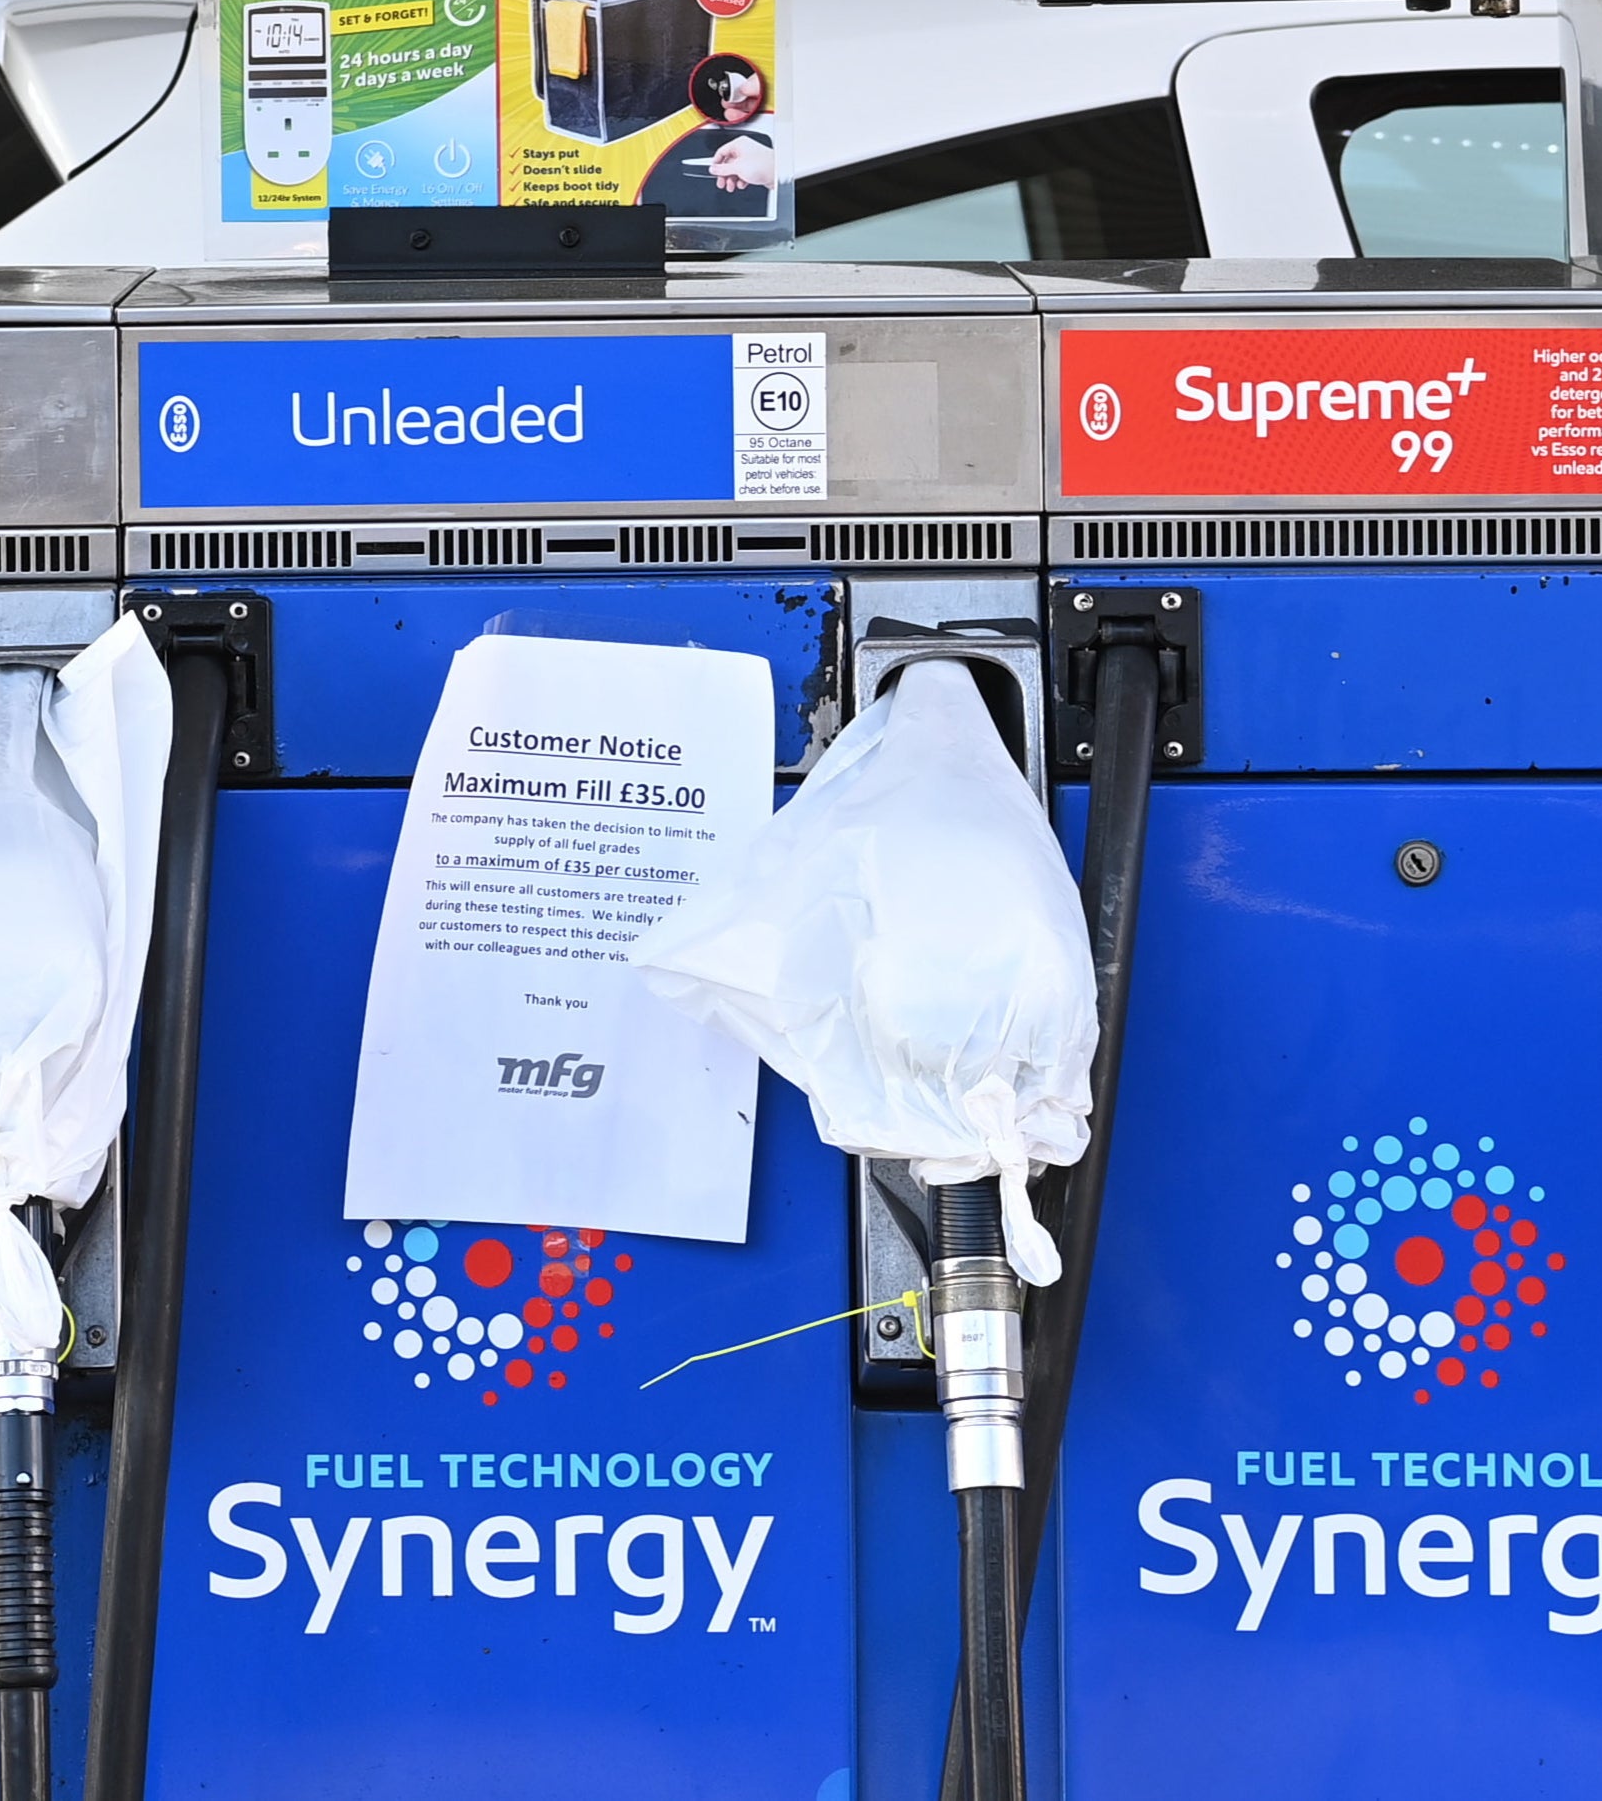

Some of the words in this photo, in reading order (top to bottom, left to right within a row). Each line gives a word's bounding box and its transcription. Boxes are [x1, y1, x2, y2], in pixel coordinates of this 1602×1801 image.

[747, 342, 813, 364] Petrol
[292, 384, 584, 447] Unleaded
[759, 389, 803, 414] E10
[749, 436, 766, 449] 95
[769, 435, 813, 450] Octane
[1391, 431, 1454, 476] 99
[468, 725, 592, 754] Customer
[598, 734, 683, 763] Notice
[445, 771, 568, 800] Maximum
[576, 779, 612, 803] Fill
[619, 782, 706, 810] £35.00
[435, 853, 449, 868] to
[453, 856, 462, 869] a
[467, 857, 541, 872] maximum
[544, 859, 560, 873] of
[564, 860, 591, 875] £35
[595, 864, 620, 879] per
[624, 865, 700, 883] customer.
[497, 1052, 605, 1098] mfg
[306, 1453, 424, 1489] FUEL
[439, 1452, 773, 1490] TECHNOLOGY
[1237, 1451, 1356, 1487] FUEL
[208, 1481, 776, 1636] Synergy
